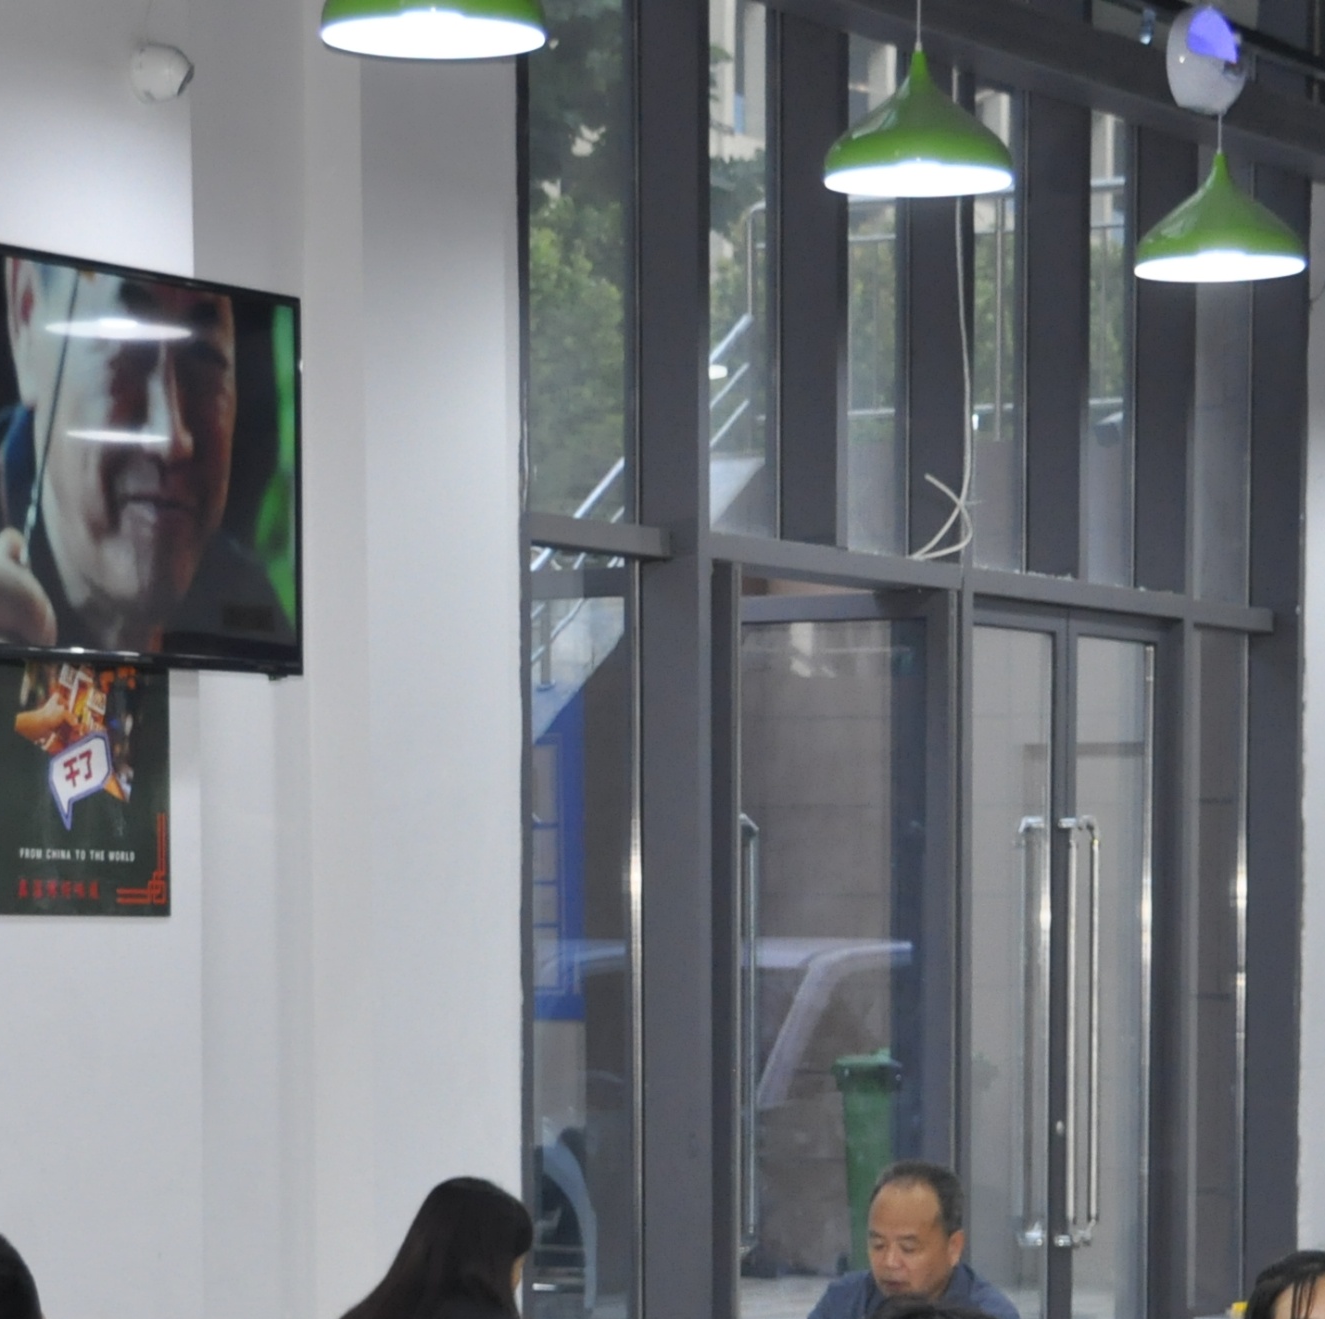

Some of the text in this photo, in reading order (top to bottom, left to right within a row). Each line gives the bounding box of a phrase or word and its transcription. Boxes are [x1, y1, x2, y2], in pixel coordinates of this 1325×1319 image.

[19, 847, 135, 863] FROM CHINA TO THE WORLD
